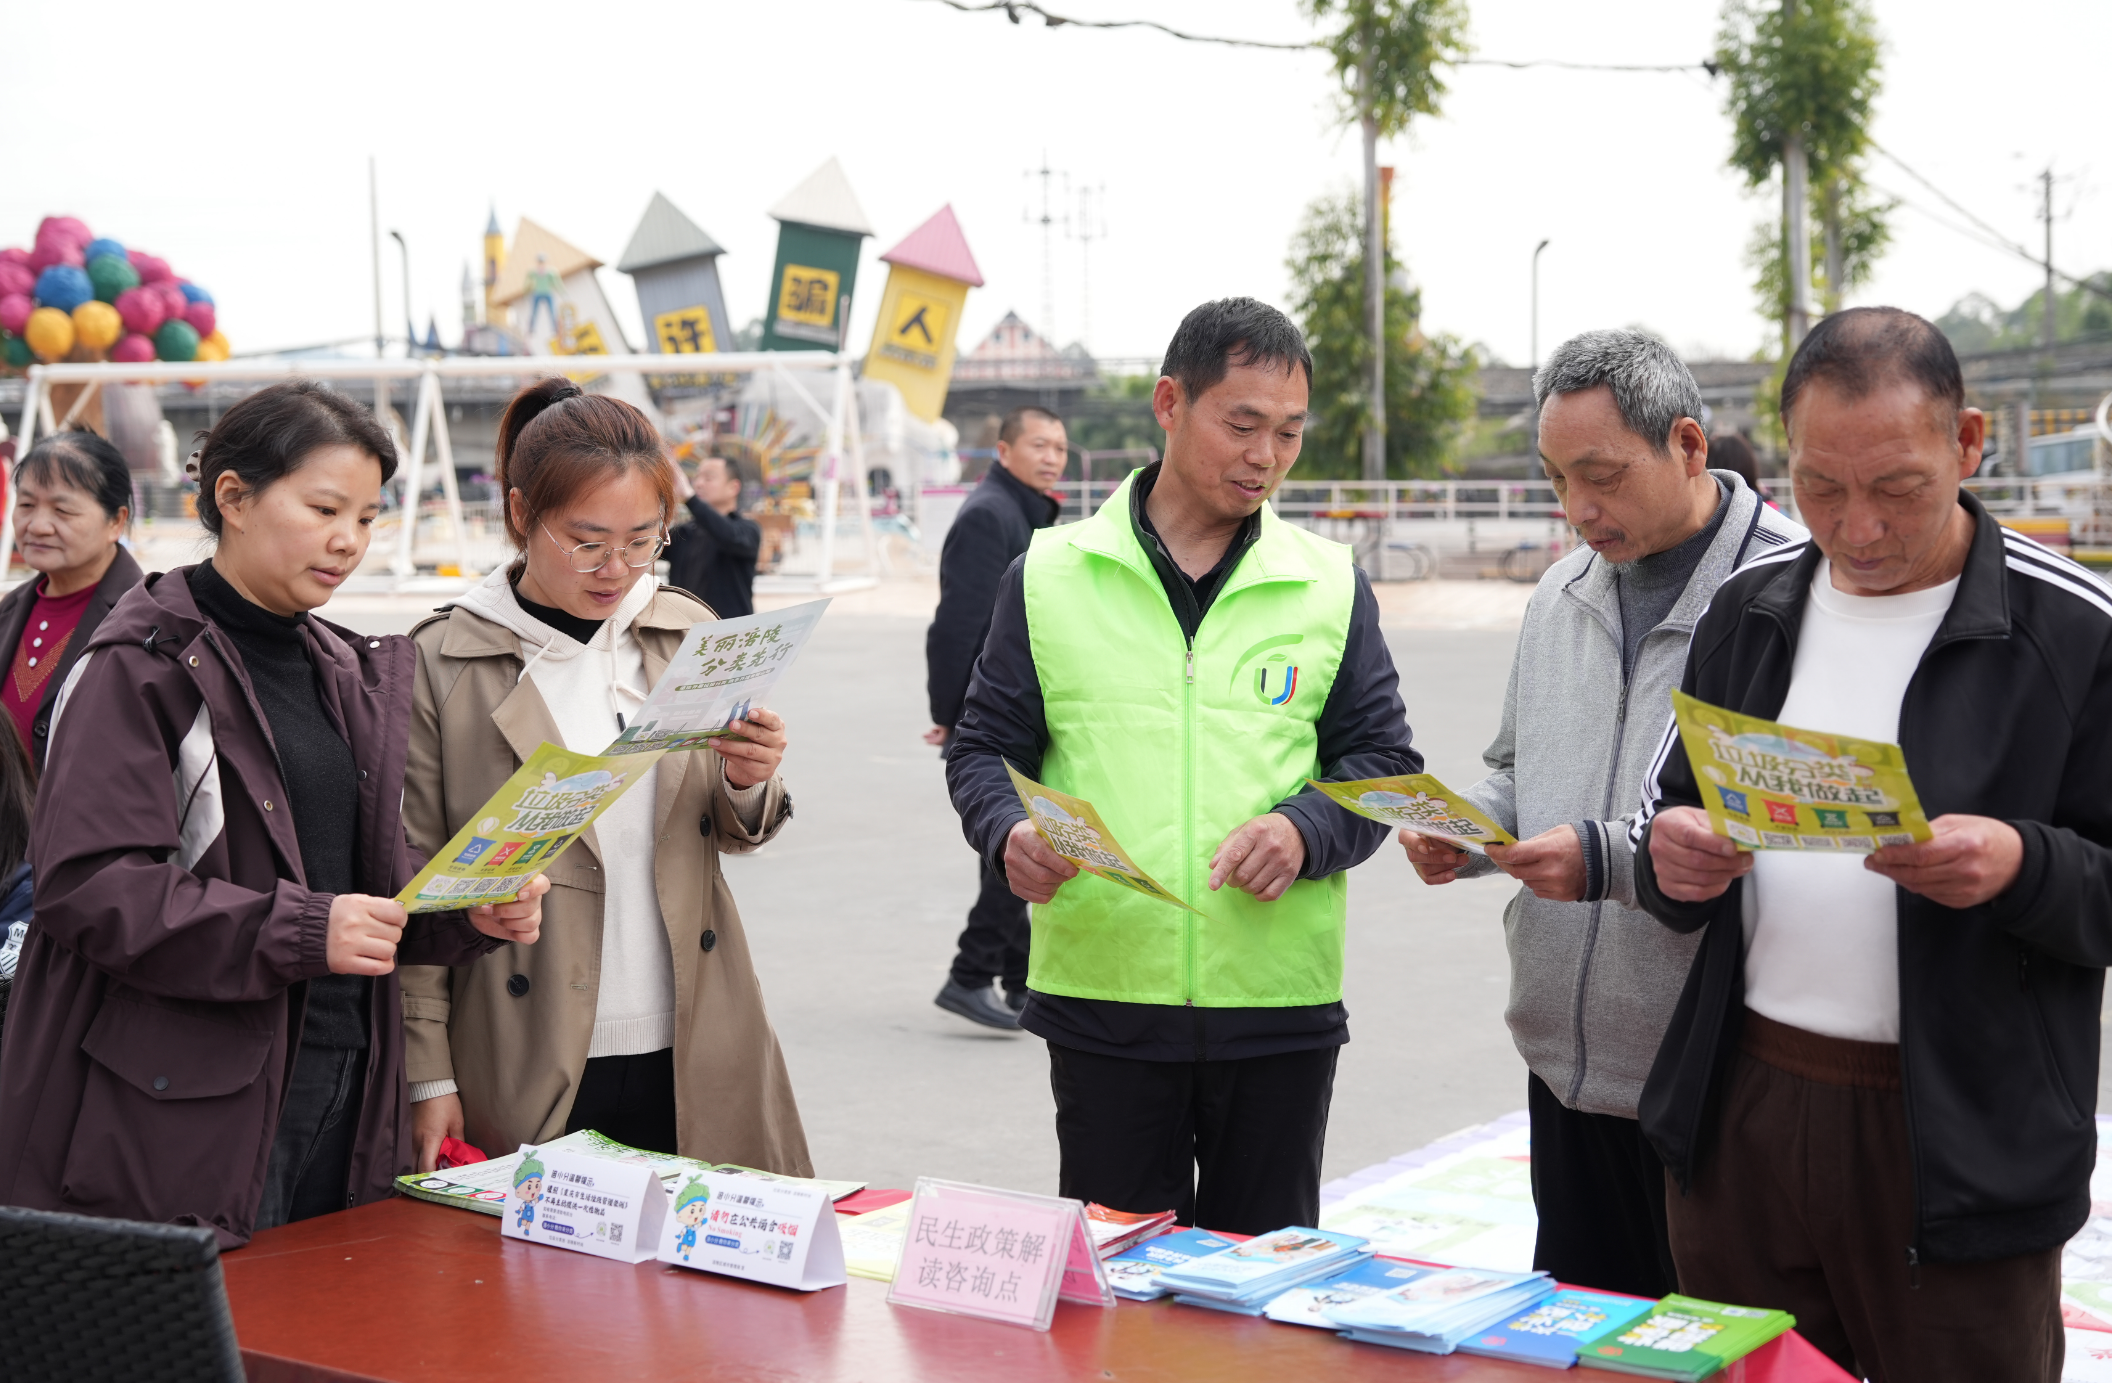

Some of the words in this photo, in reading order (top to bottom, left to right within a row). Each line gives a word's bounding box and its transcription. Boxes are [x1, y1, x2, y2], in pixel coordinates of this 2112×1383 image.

[900, 306, 932, 344] 人
[692, 624, 783, 656] 美丽涪陵
[700, 642, 794, 677] 分类先行
[1712, 742, 1853, 782] 垃圾分类
[514, 783, 612, 812] 垃圾分类
[1739, 767, 1885, 805] 从我做起
[506, 803, 600, 831] 从我做起
[1050, 834, 1130, 872] 从我做起
[717, 1226, 743, 1238] Smoking
[914, 1215, 1047, 1265] 民生政策解
[917, 1257, 1023, 1303] 读咨询点
